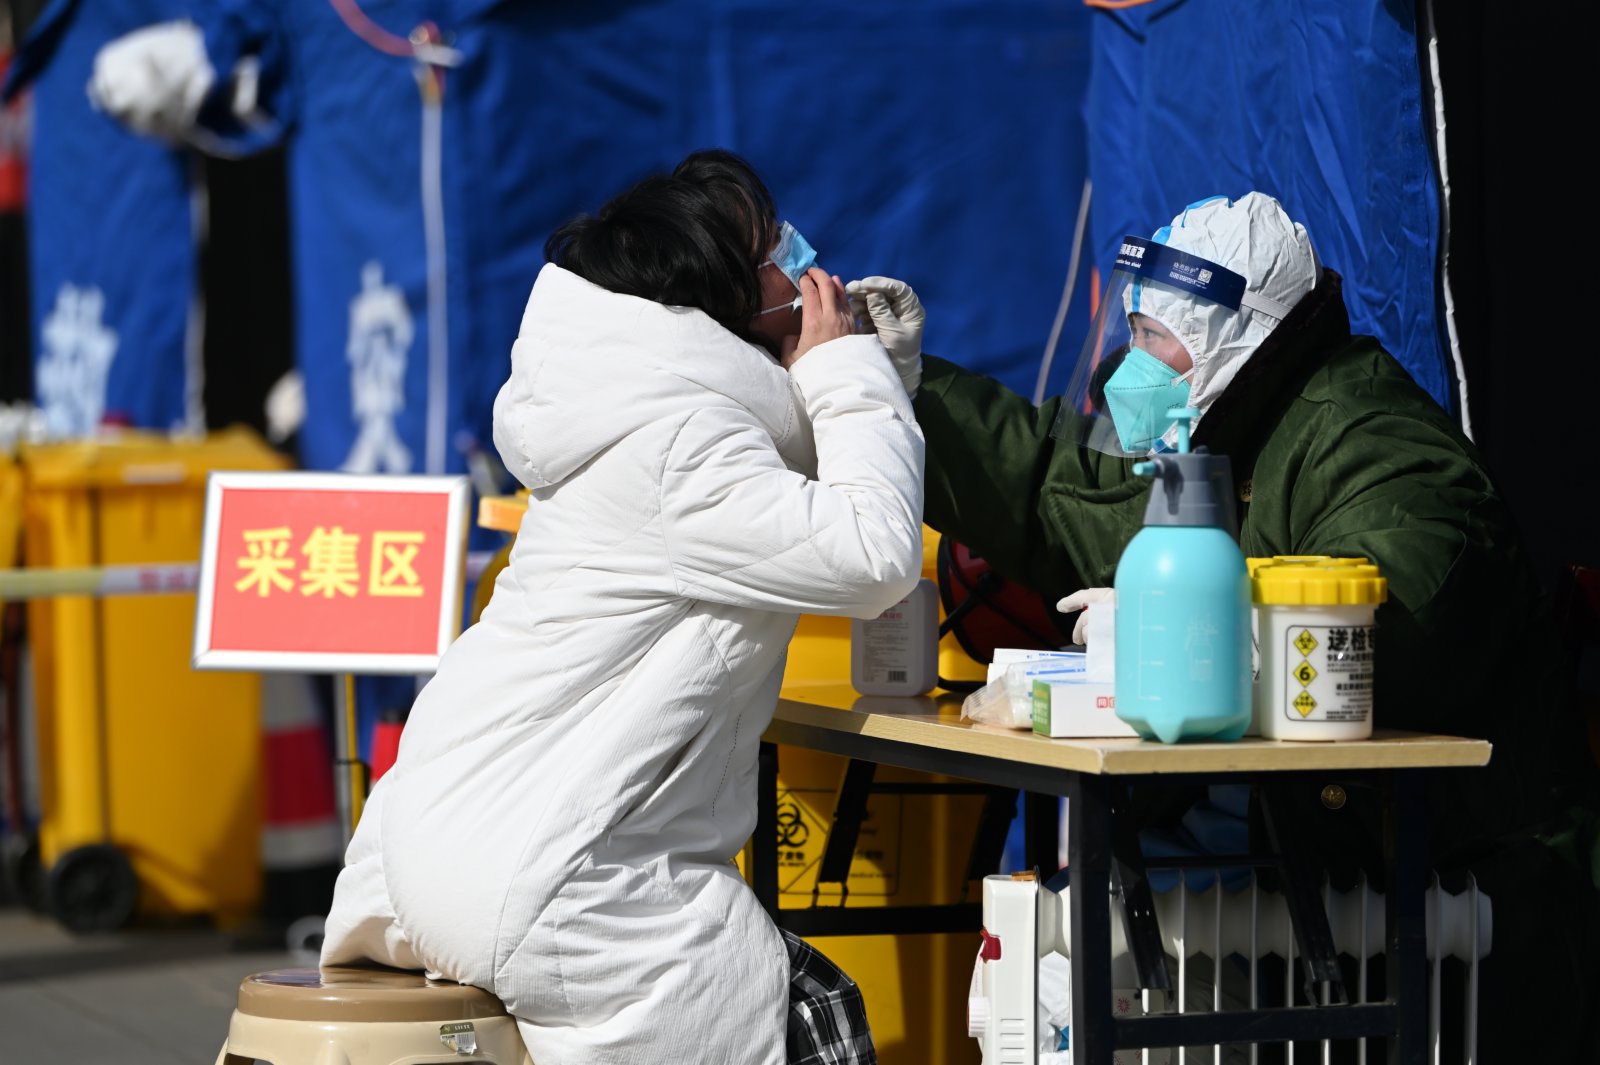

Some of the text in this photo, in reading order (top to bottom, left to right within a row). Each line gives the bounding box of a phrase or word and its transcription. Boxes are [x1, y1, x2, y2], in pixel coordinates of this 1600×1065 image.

[234, 525, 425, 598] 采集区
[1300, 666, 1311, 681] 6
